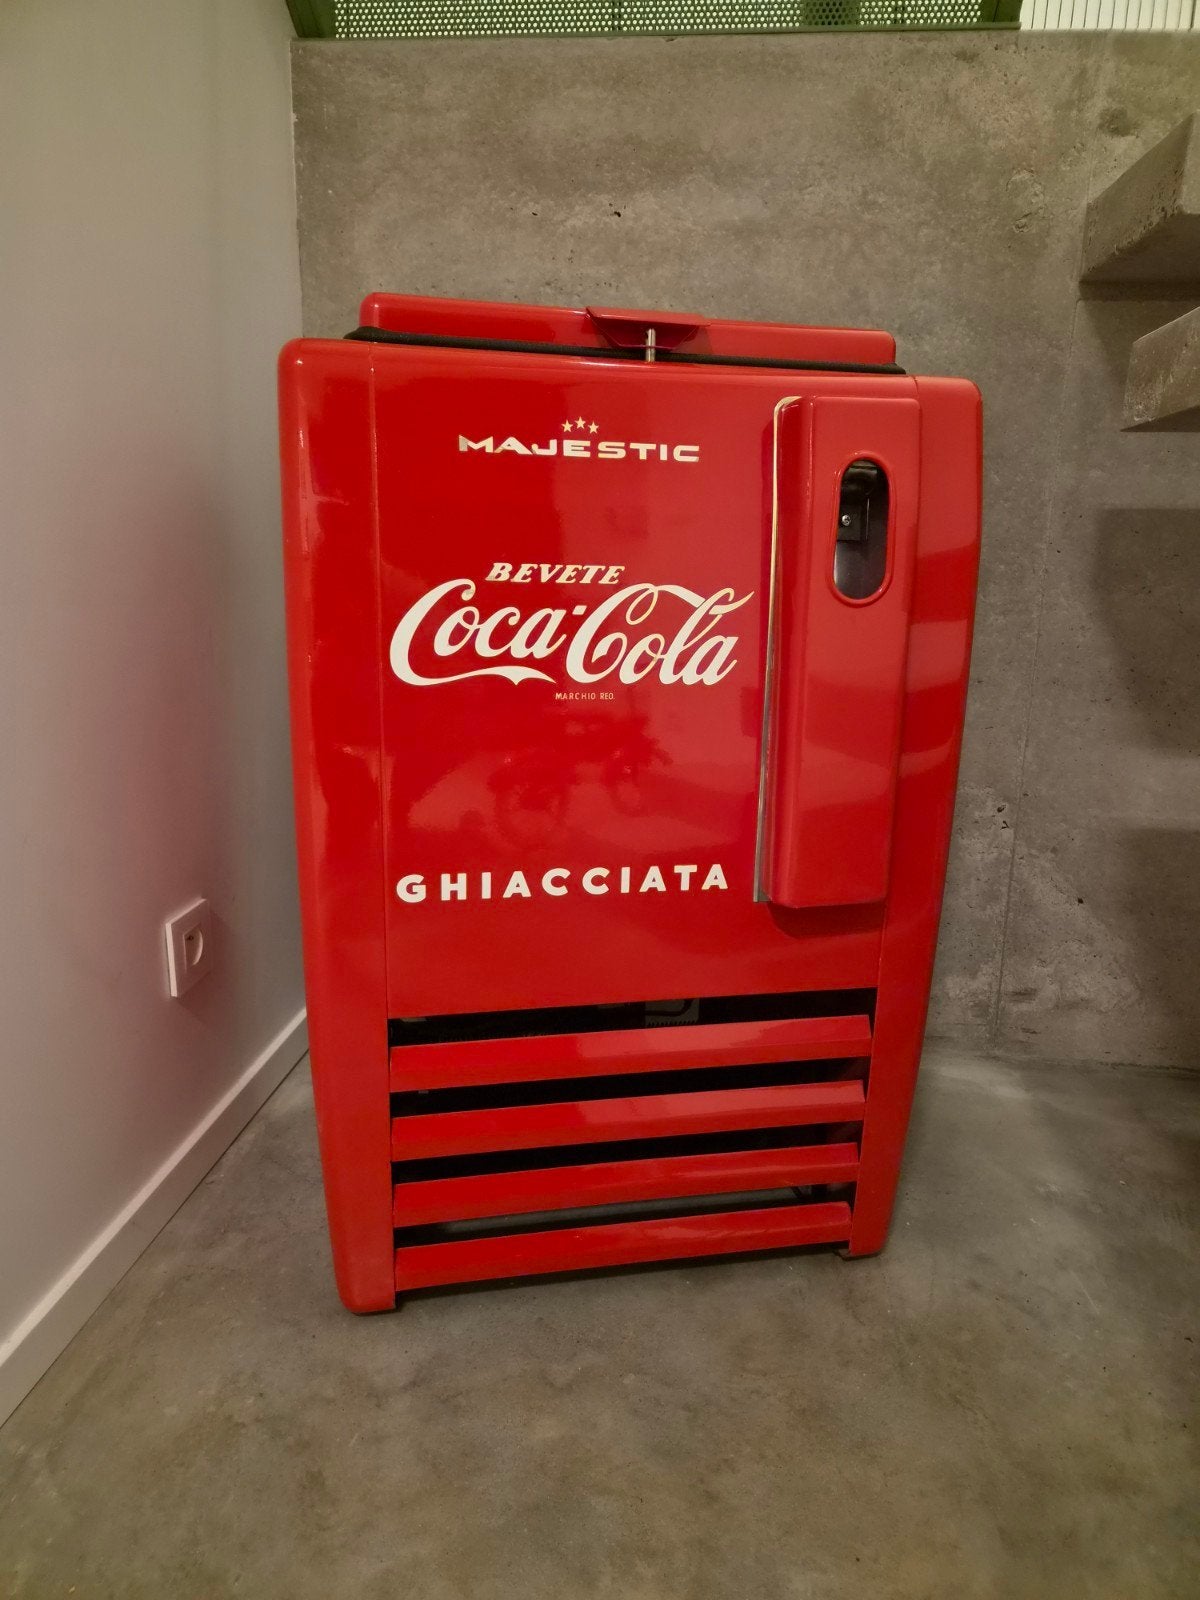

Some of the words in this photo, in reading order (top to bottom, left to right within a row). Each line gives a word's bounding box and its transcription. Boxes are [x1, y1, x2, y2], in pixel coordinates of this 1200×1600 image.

[458, 434, 700, 463] MAJESTIC
[485, 562, 626, 585] BEVETE
[389, 578, 755, 686] Coca-Cola
[555, 692, 596, 700] MARCHIO
[396, 863, 729, 904] GHIACCIATA
